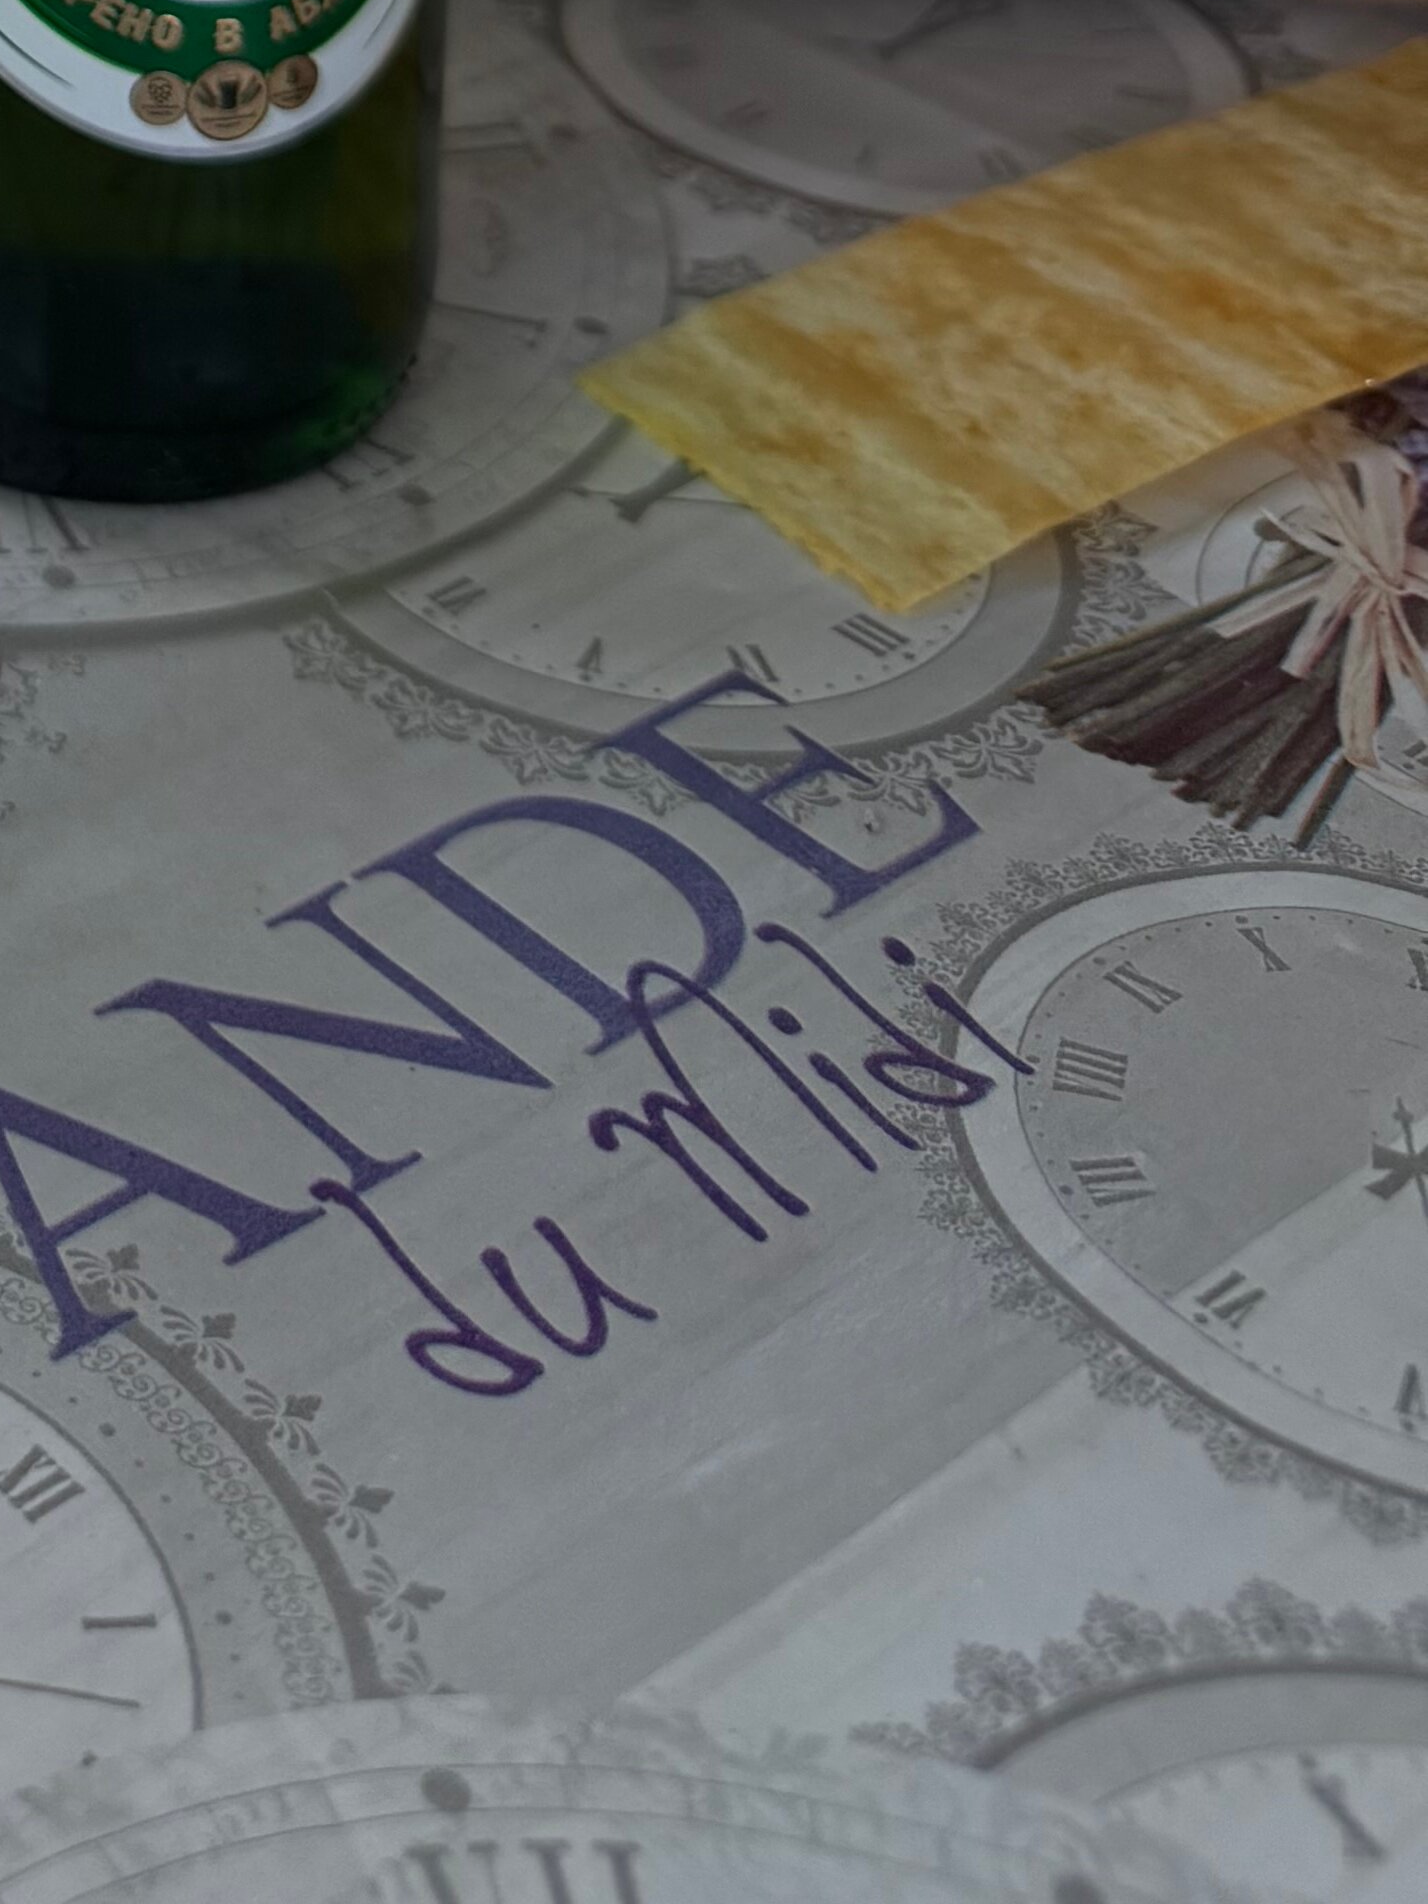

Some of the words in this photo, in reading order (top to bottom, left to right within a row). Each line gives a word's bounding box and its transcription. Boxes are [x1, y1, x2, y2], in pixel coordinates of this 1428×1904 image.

[215, 17, 243, 53] В
[309, 1179, 658, 1397] du
[589, 923, 1034, 1243] Midi
